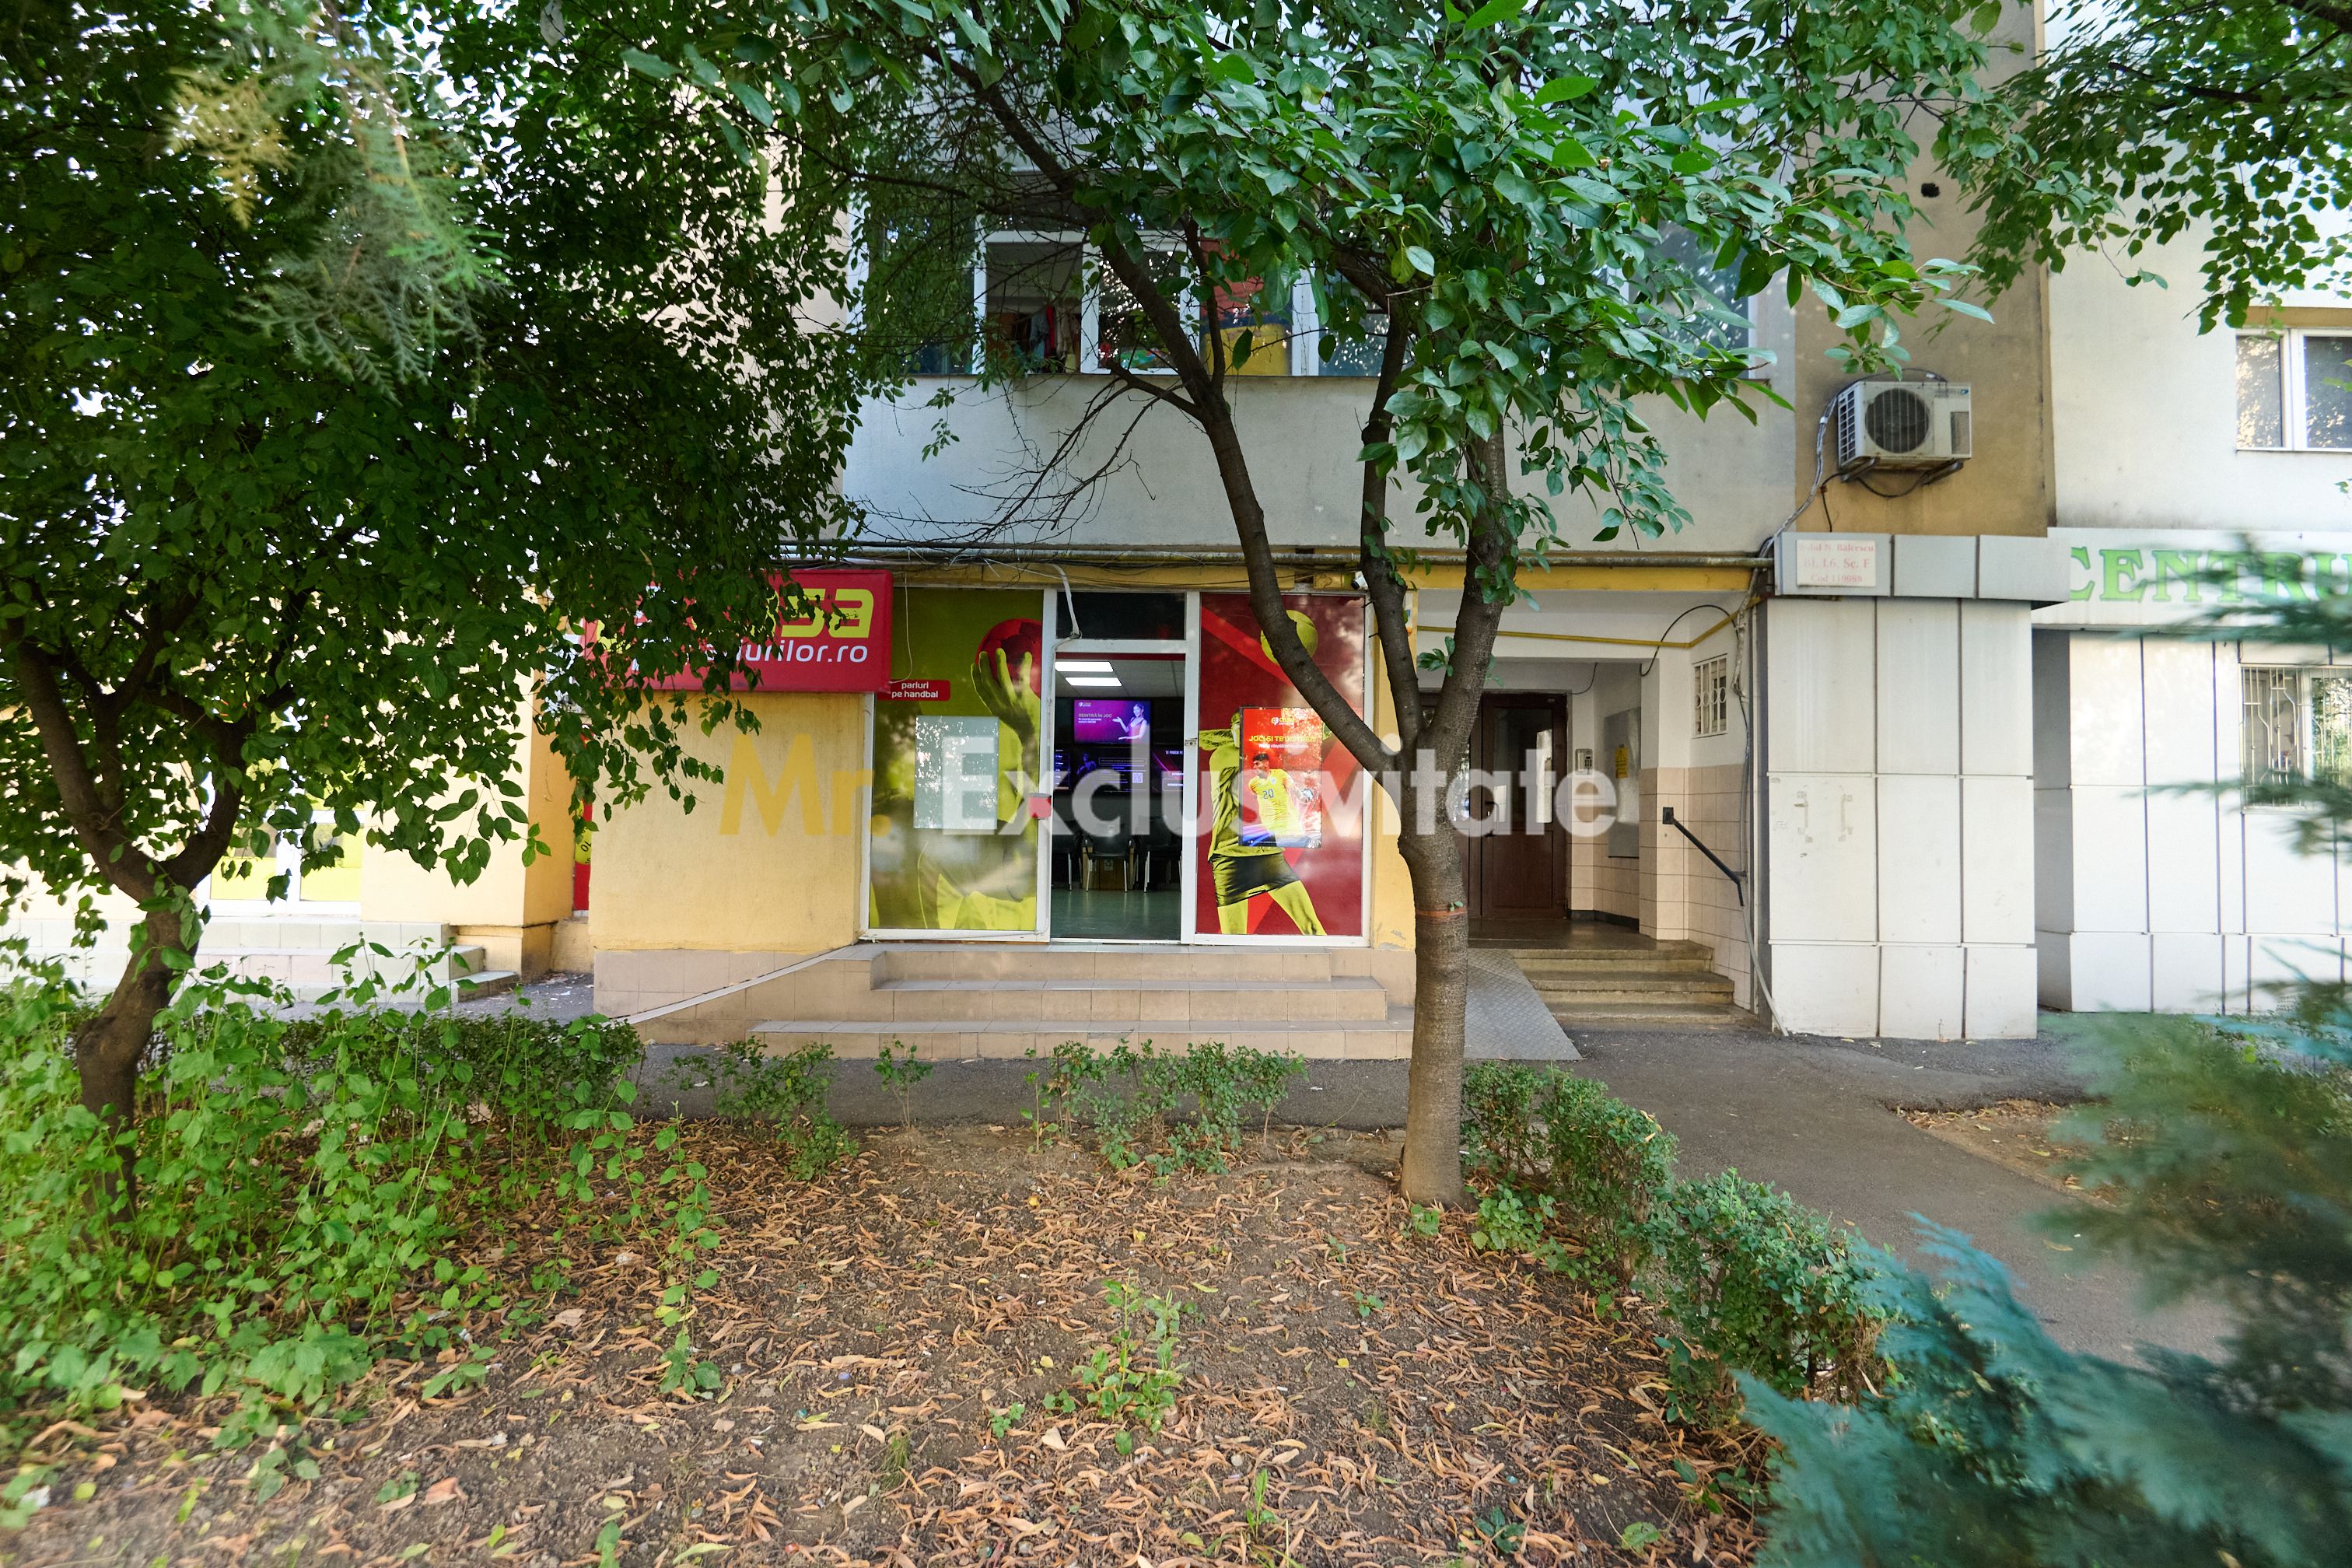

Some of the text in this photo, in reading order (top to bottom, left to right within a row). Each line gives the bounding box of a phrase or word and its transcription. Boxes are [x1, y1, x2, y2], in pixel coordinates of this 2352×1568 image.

[1843, 558, 1859, 569] Sc.
[1811, 573, 1829, 583] Cod
[901, 681, 929, 690] pariuri
[904, 690, 939, 698] handbal
[1262, 789, 1274, 799] 20
